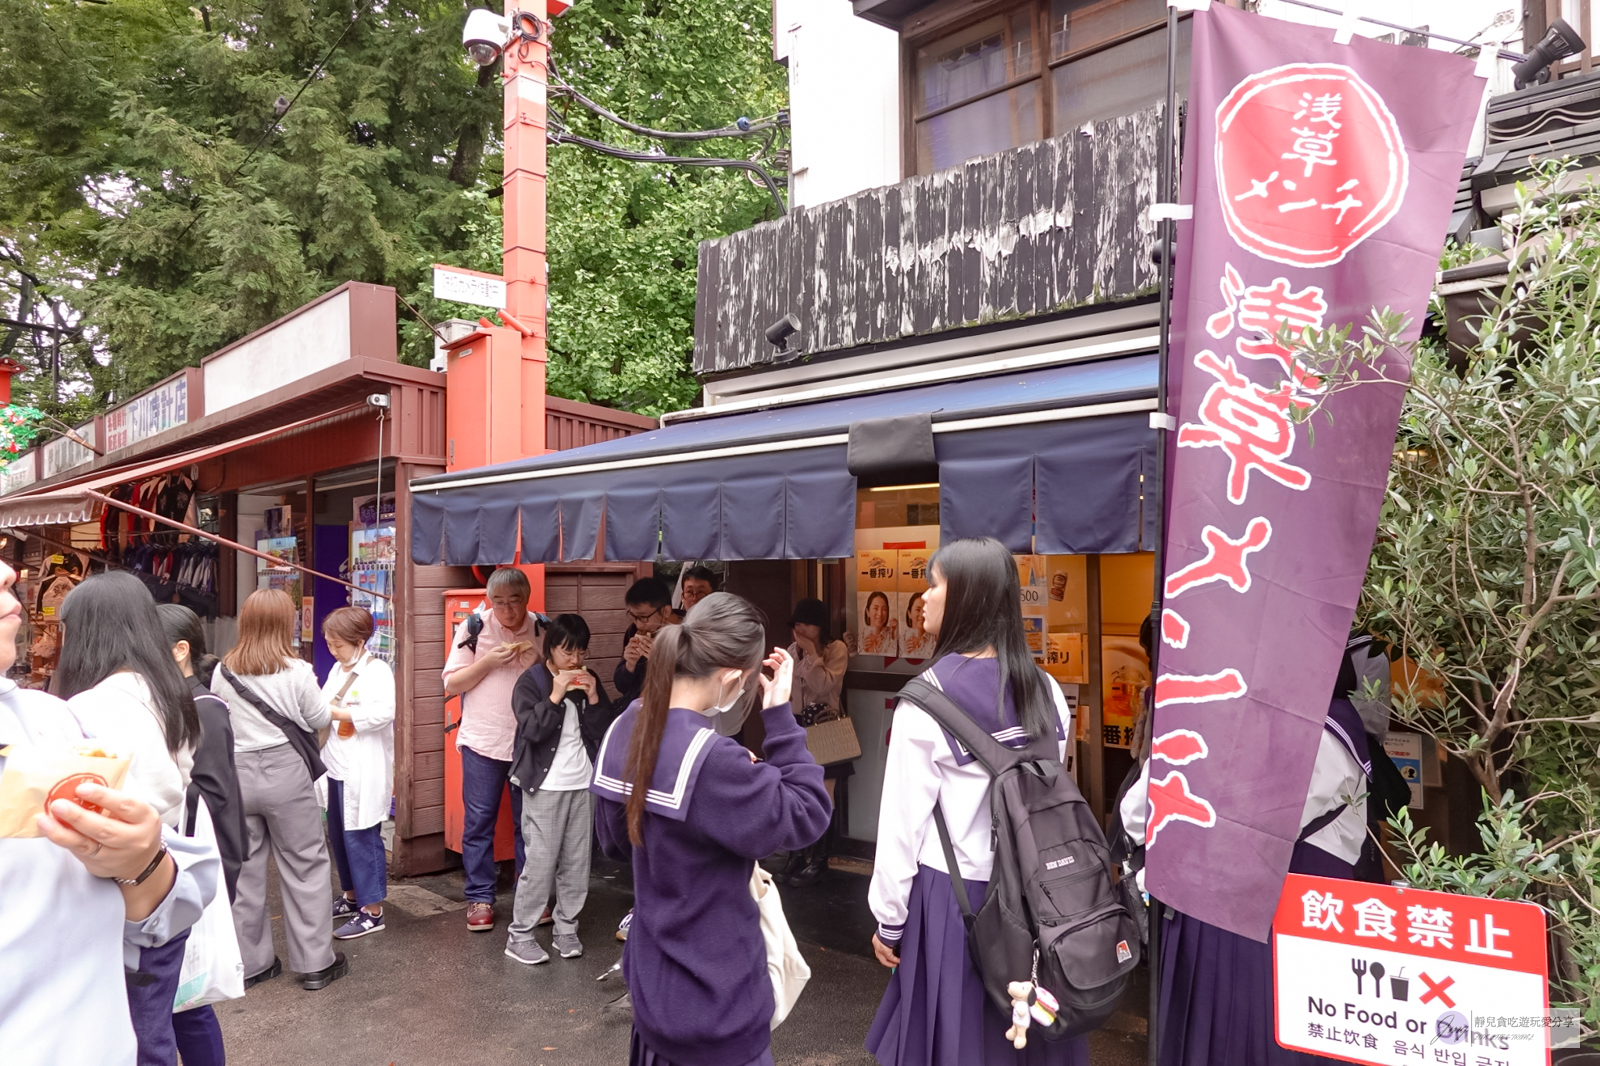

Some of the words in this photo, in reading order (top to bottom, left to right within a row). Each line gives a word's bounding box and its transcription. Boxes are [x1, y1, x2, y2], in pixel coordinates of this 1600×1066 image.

[1281, 92, 1342, 177] 浅草
[1234, 171, 1363, 225] メンチ
[128, 379, 186, 442] 下川時計店
[861, 568, 894, 579] 一番搾り
[1301, 889, 1513, 959] 飲食禁止
[1307, 1021, 1379, 1051] 禁止饮食
[1308, 995, 1337, 1017] No
[1344, 1002, 1397, 1029] Food
[1405, 1018, 1428, 1035] or
[1393, 1039, 1425, 1060] 음식
